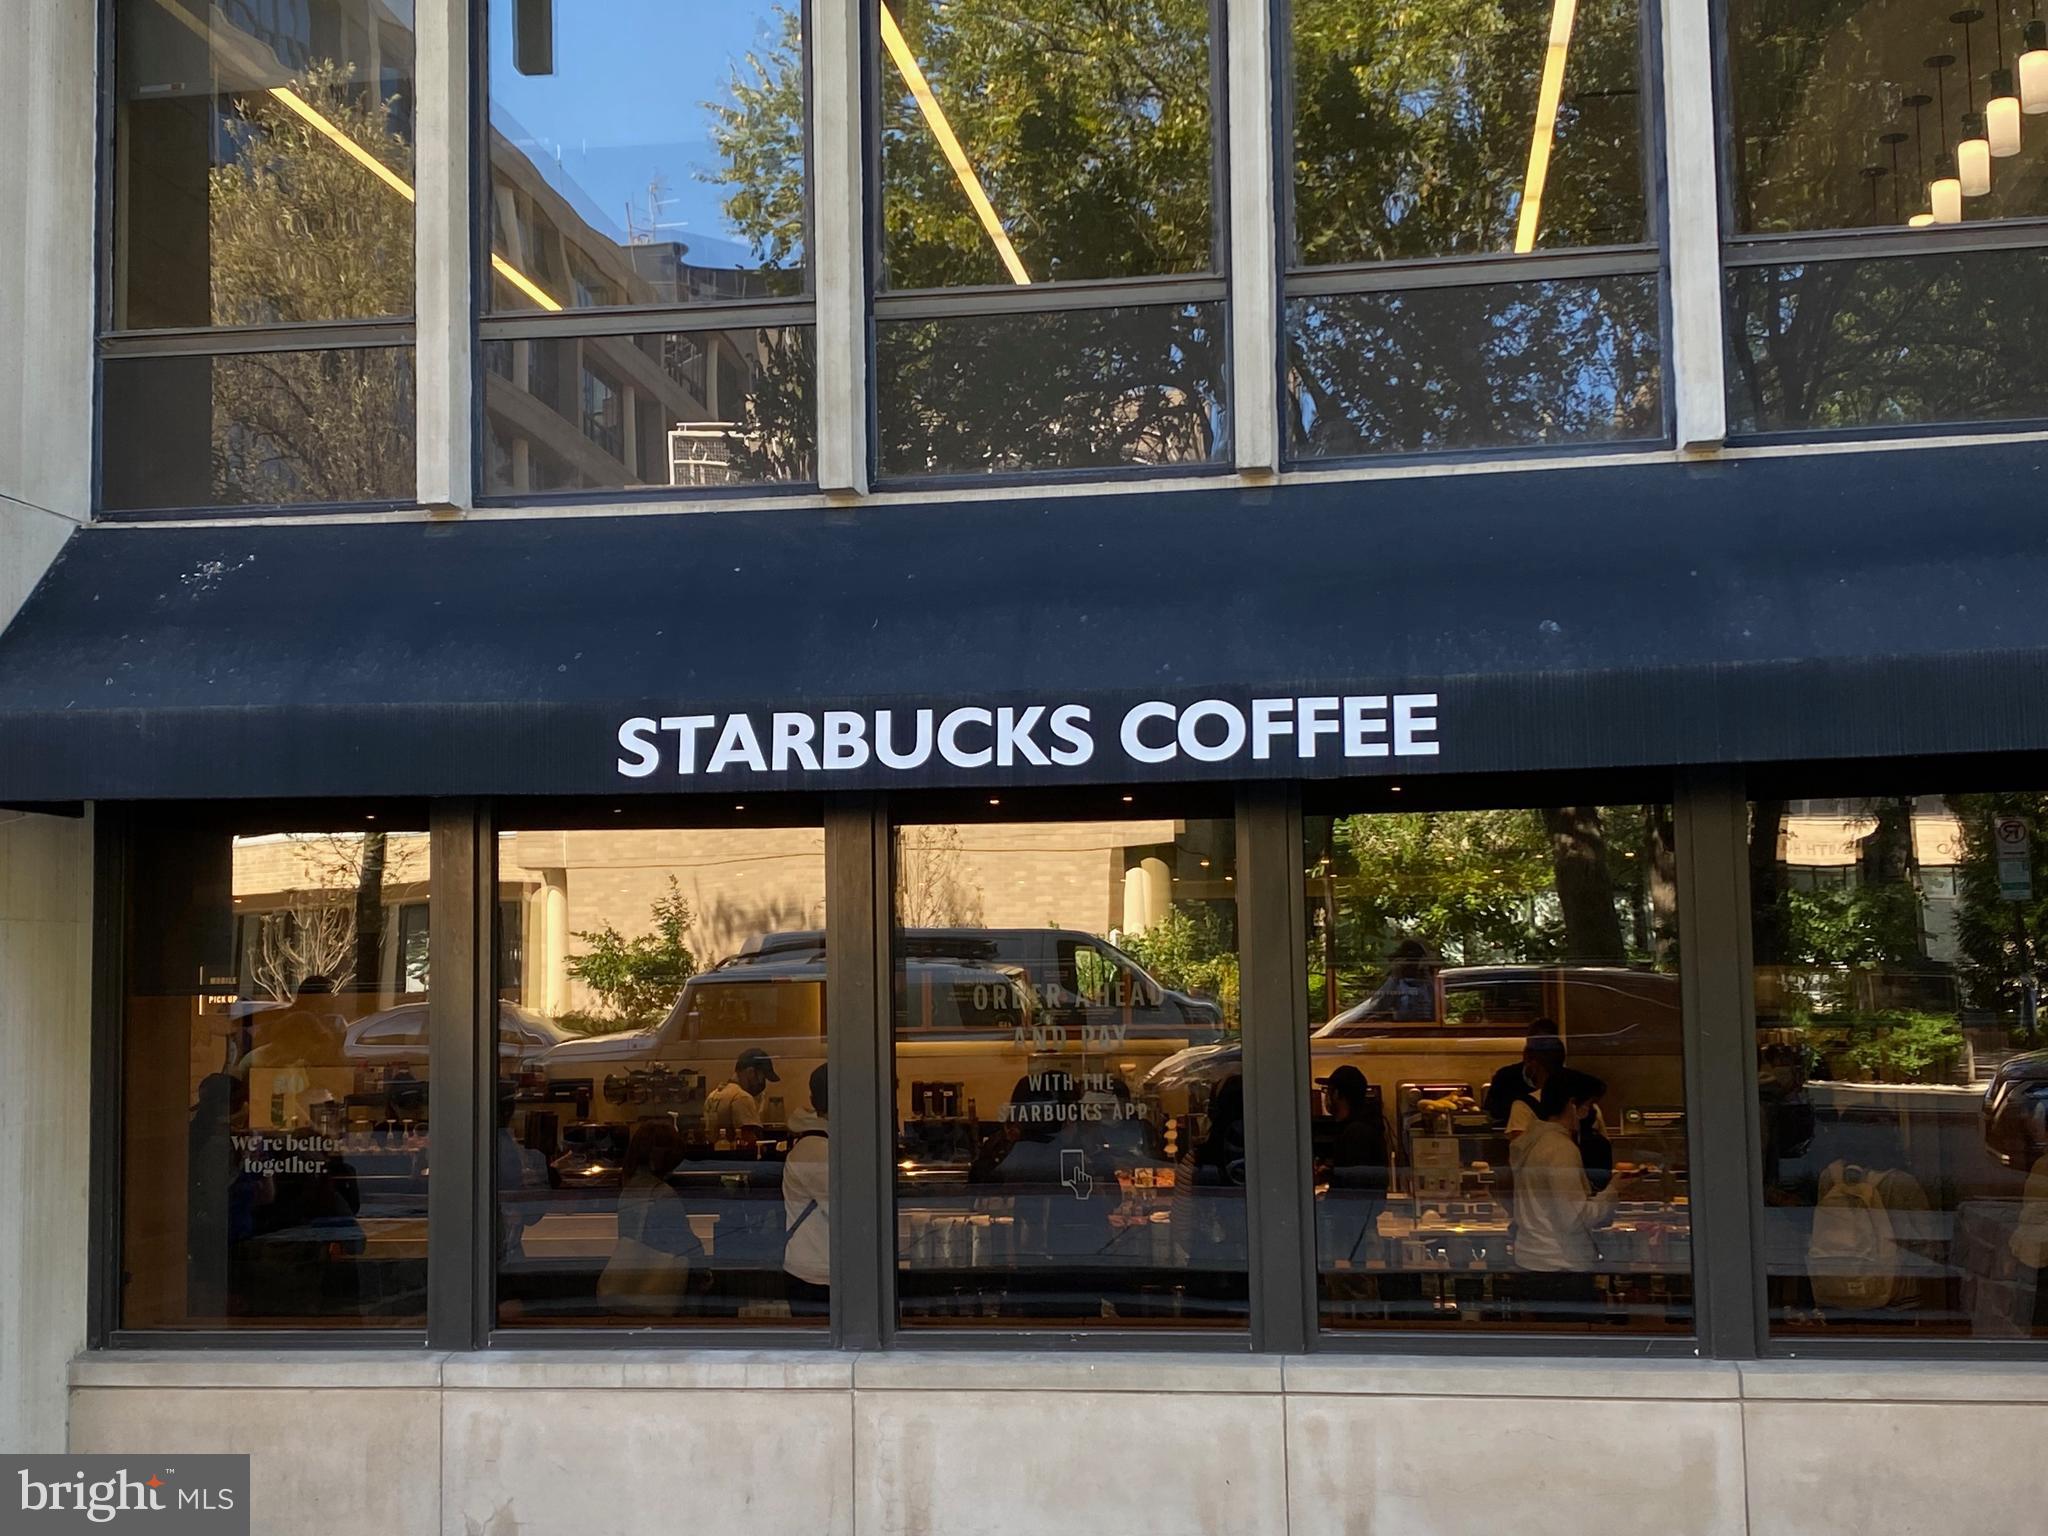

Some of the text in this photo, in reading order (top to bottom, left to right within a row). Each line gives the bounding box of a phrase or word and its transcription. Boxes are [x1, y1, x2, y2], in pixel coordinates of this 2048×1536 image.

[617, 693, 1440, 778] STARBUCKS COFFEE
[208, 995, 238, 1005] PICK UP
[973, 981, 1165, 1011] ORDER AHEAD
[1013, 1024, 1128, 1052] AND PAY
[1028, 1073, 1115, 1092] WITH THE
[998, 1102, 1149, 1123] STARBUCKS APP
[230, 1135, 283, 1152] We're
[244, 1155, 328, 1177] together.
